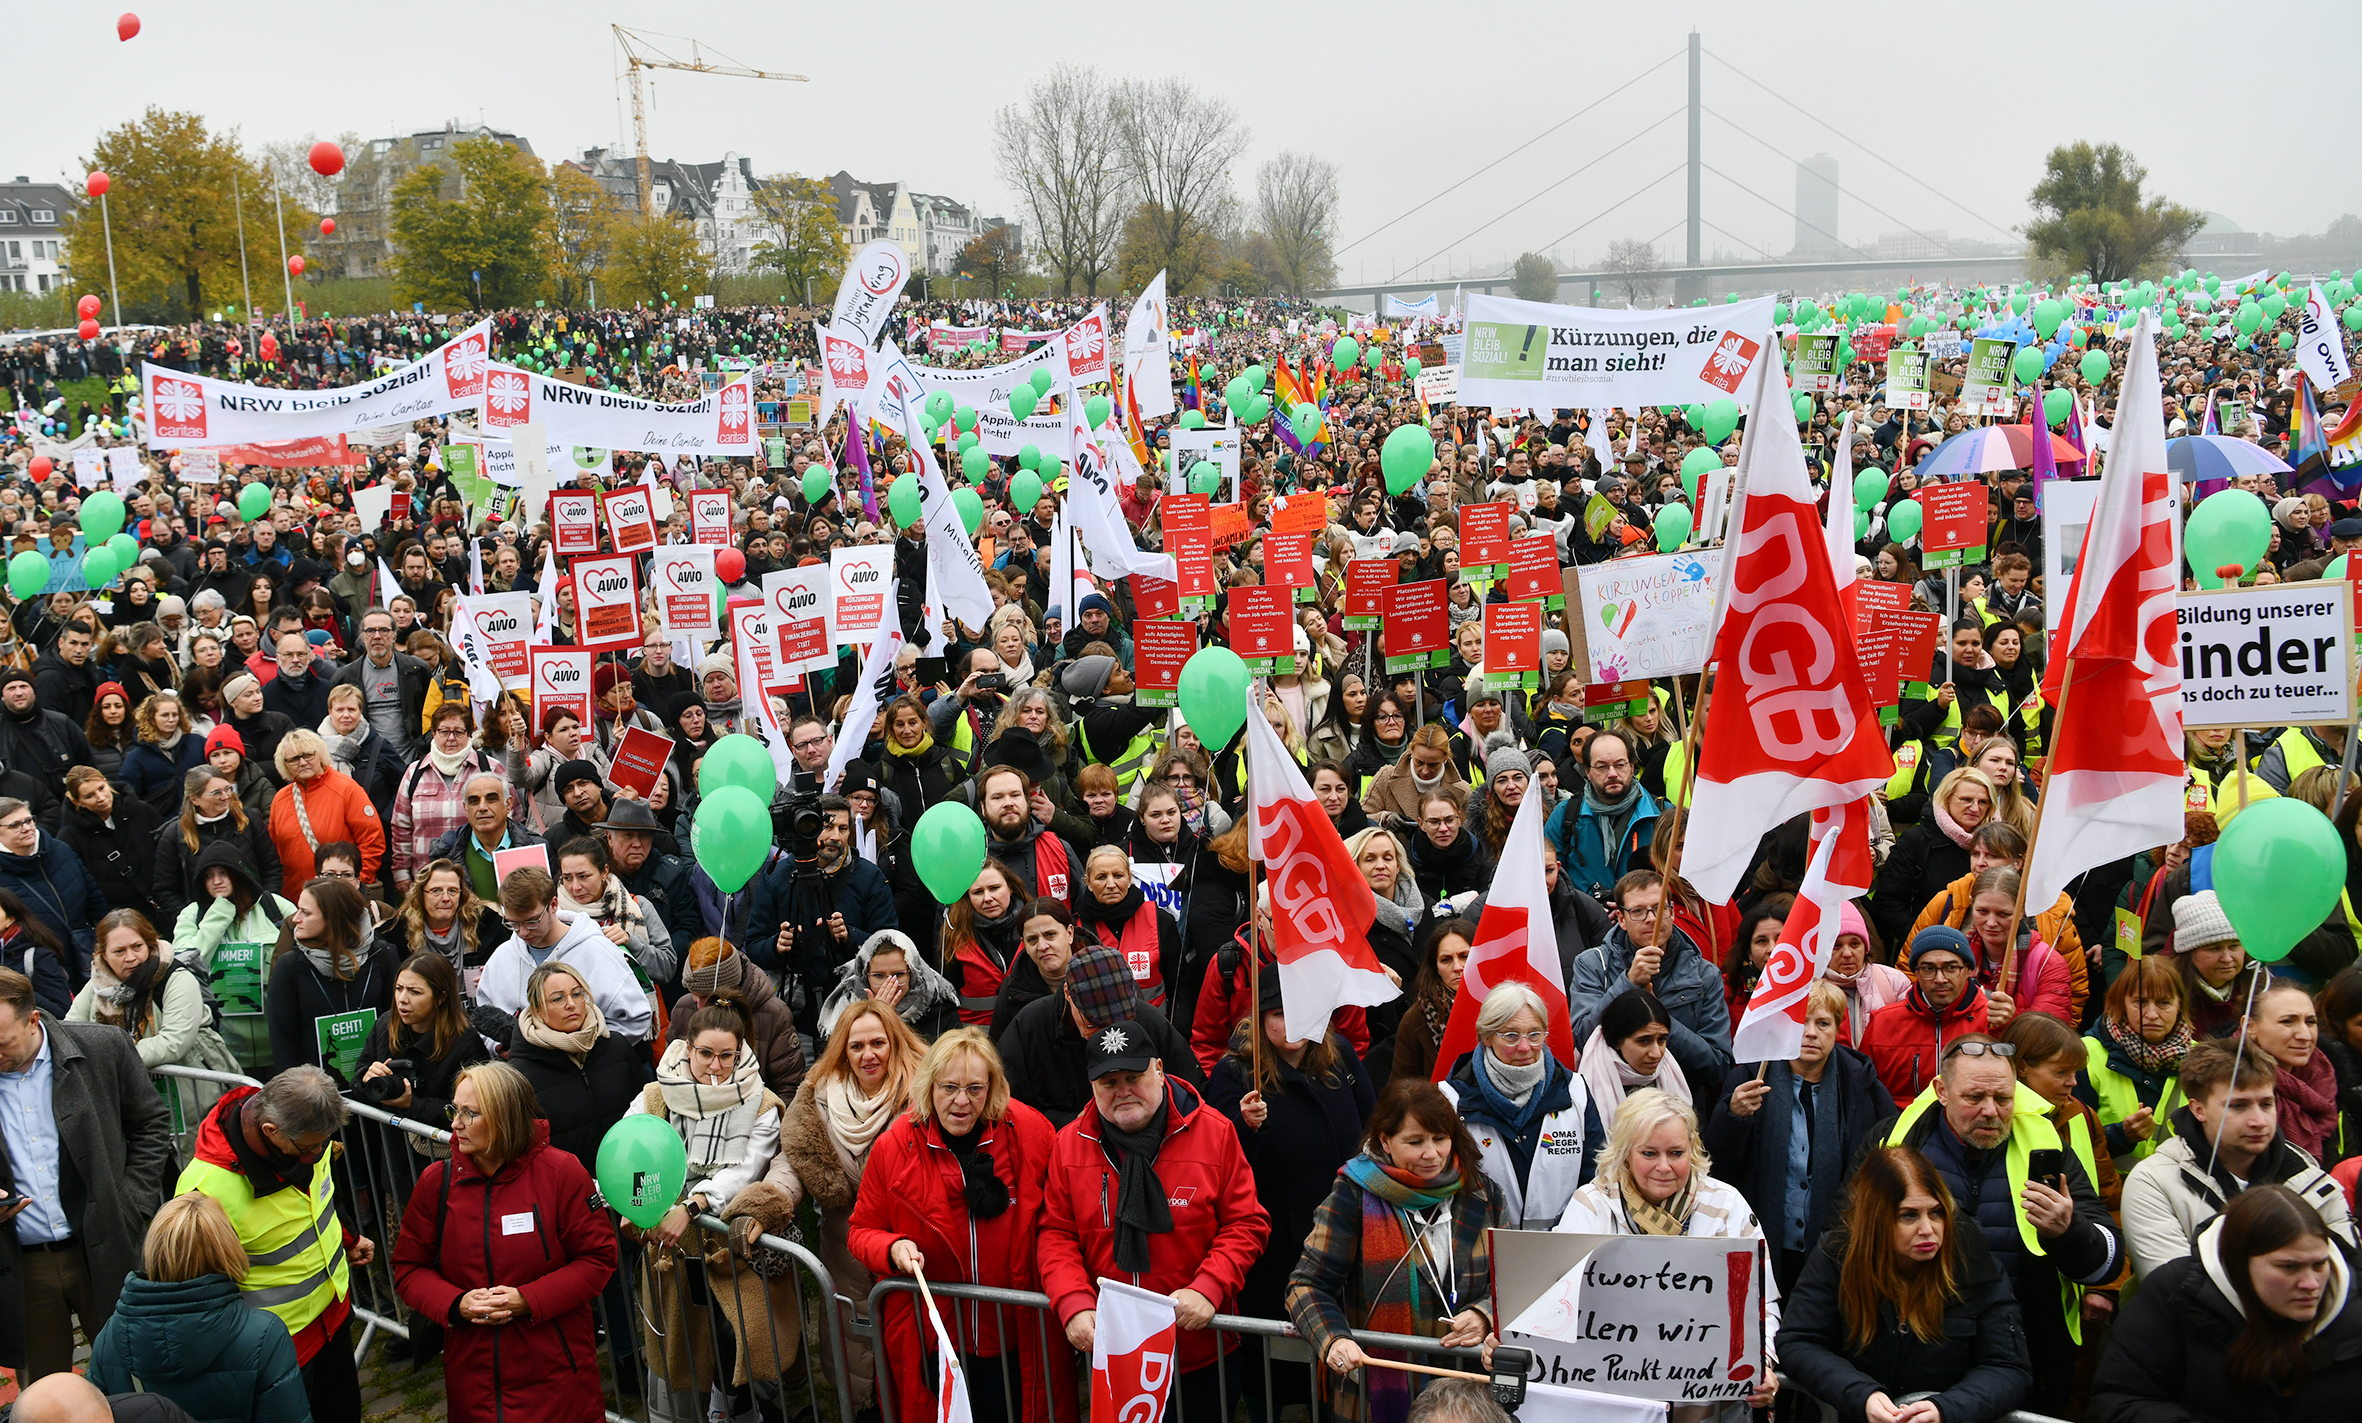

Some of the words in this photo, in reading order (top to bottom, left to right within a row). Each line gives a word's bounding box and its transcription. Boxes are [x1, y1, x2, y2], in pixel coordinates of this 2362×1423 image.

[843, 287, 862, 318] Kölner
[1474, 327, 1497, 339] NRW
[1551, 327, 1680, 350] Kürzungen,
[1686, 325, 1717, 344] die
[1473, 339, 1501, 351] BLEIB
[1813, 339, 1832, 349] NRW
[1807, 350, 1831, 360] BLEIB
[1936, 348, 1959, 357] PREIS
[1988, 345, 2010, 357] NRW
[1472, 352, 1507, 364] SOZIAL!
[1547, 356, 1598, 372] man
[1605, 353, 1666, 372] sieht!
[1904, 355, 1924, 366] NRW
[1981, 357, 2006, 370] BLEIB
[2317, 342, 2341, 383] OWL
[1798, 361, 1830, 371] SOZIAL!
[1899, 366, 1923, 377] BLEIB
[1546, 374, 1614, 384] #nrwbleibsozial
[1970, 368, 2004, 382] SOZIAL!
[220, 394, 283, 411] NRW
[293, 396, 351, 411] bleib
[360, 363, 431, 399] sozial!
[1890, 377, 1923, 388] SOZIAL!
[543, 385, 592, 405] NRW
[601, 396, 647, 410] bleib
[355, 412, 385, 425] Deine
[391, 399, 434, 417] Caritas
[489, 415, 526, 426] caritas
[158, 424, 204, 437] caritas
[643, 431, 667, 446] Deine
[672, 433, 704, 448] Caritas
[719, 431, 747, 443] caritas
[449, 450, 467, 459] GEHT!
[491, 487, 510, 501] NRW
[485, 497, 507, 511] BLEIB
[1231, 503, 1244, 513] JA
[567, 508, 586, 516] AWO
[623, 505, 644, 517] AWO
[706, 507, 725, 516] AWO
[678, 571, 702, 583] AWO
[851, 571, 879, 583] AWO
[597, 577, 628, 592] AWO
[1397, 585, 1431, 594] Platzverweis!
[1598, 571, 1679, 602] KÜRZUNGEN
[1864, 583, 1896, 591] Integration!?
[788, 593, 816, 609] AWO
[1395, 601, 1424, 609] Sparplänen
[839, 603, 880, 612] ZURÜCKNEHMEN!
[1389, 607, 1432, 617] Landesregierung
[2177, 606, 2250, 625] Bildung
[2257, 602, 2334, 619] unserer
[488, 619, 517, 632] AWO
[792, 621, 811, 630] STABILE
[785, 629, 820, 641] FINANZIERUNG
[1731, 513, 1857, 762] DGB
[797, 640, 810, 648] STATT
[790, 648, 820, 660] KÜRZUNGEN!
[2181, 626, 2336, 679] inder
[1392, 664, 1408, 672] BLEIB
[1409, 661, 1429, 670] SOZIAL!
[552, 670, 580, 682] AWO
[542, 694, 584, 703] WERTSCHÄTZUNG
[2202, 685, 2245, 702] doch
[2249, 687, 2270, 699] zu
[2275, 684, 2338, 698] teuer...
[1259, 799, 1344, 946] DGB
[218, 949, 253, 962] IMMER!
[332, 1019, 363, 1036] GEHT!
[640, 1172, 660, 1186] NRW
[636, 1184, 661, 1196] BLEIB
[629, 1193, 662, 1206] SOZIAL!
[1583, 1260, 1713, 1294] tworten
[1658, 1318, 1720, 1342] wir
[1602, 1354, 1661, 1381] Punkt
[1666, 1356, 1718, 1380] und
[1682, 1380, 1754, 1400] KOMMA
